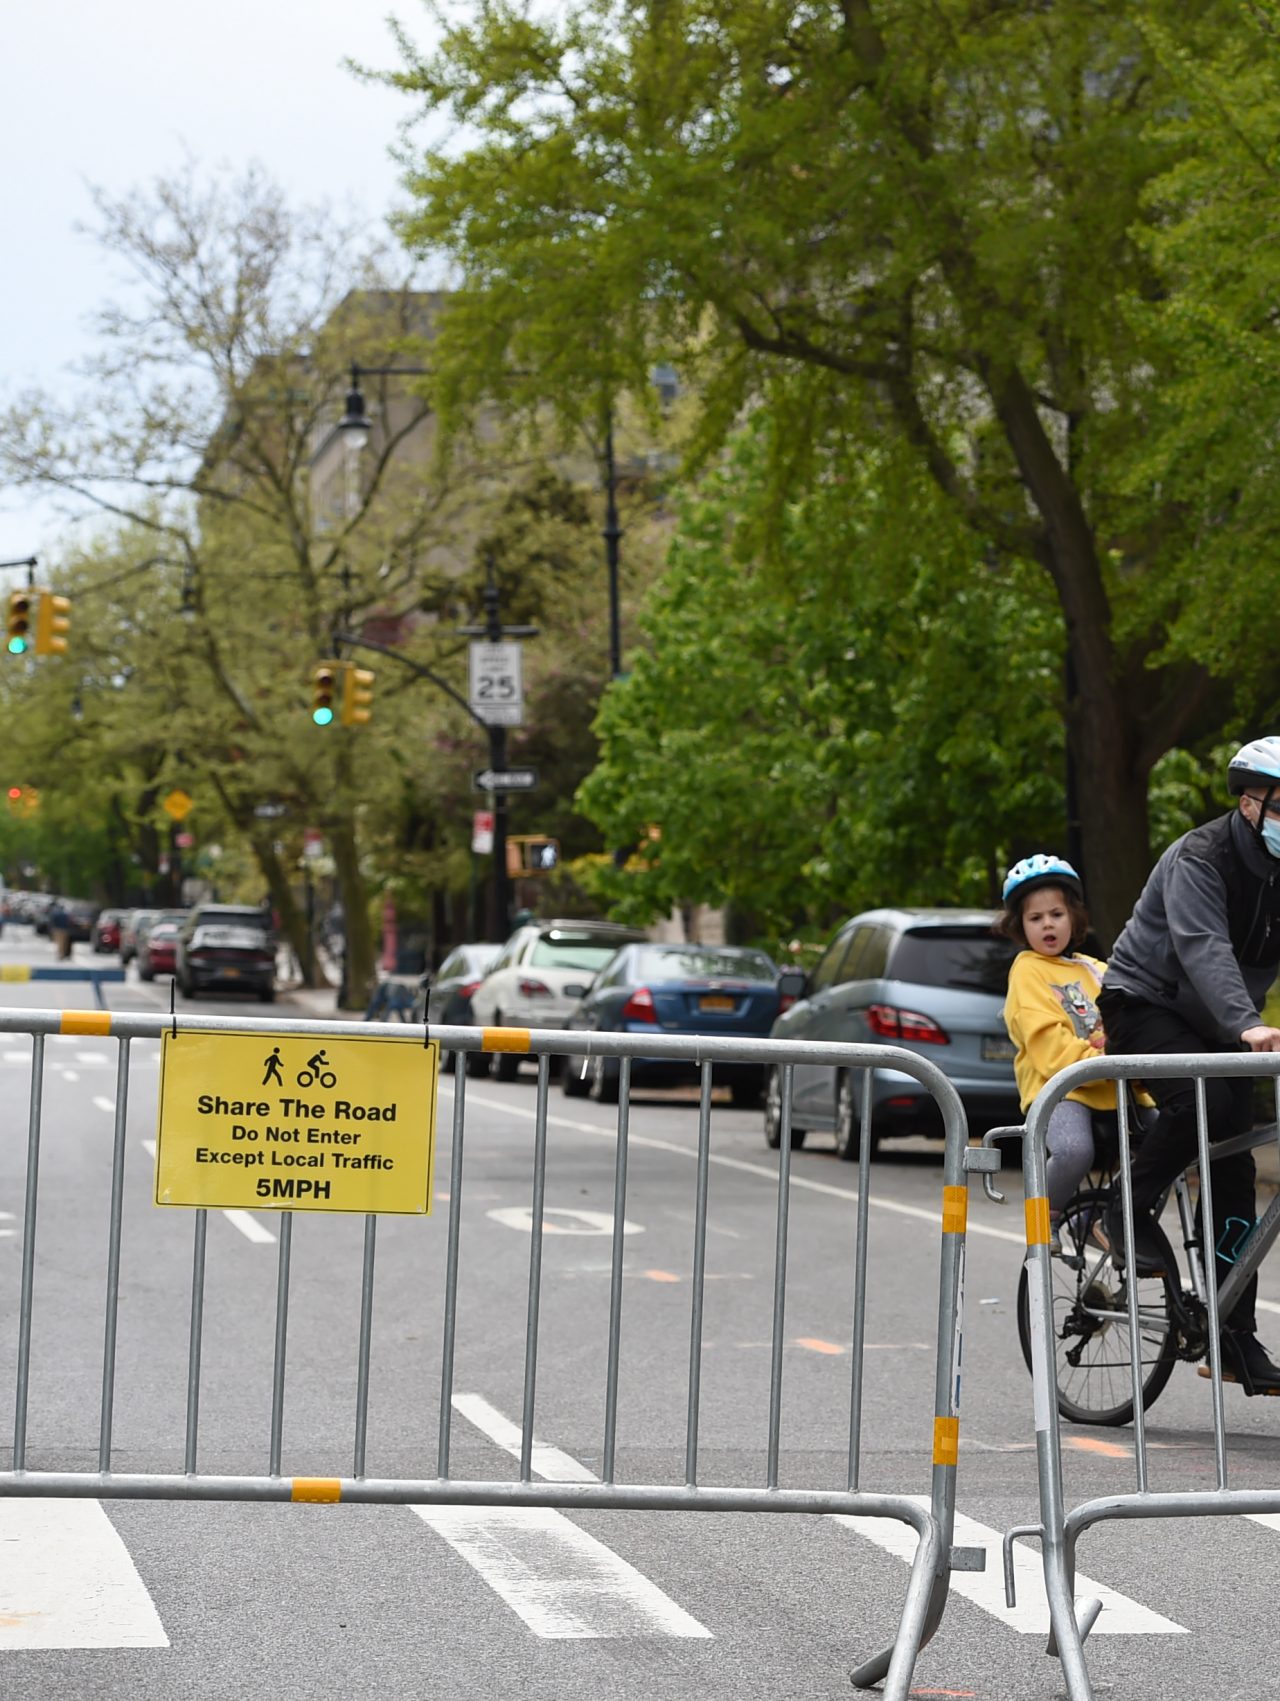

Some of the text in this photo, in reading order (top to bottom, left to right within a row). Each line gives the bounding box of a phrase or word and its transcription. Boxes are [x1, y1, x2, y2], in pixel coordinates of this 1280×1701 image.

[478, 676, 515, 699] 25
[198, 1095, 397, 1122] Share The Road
[232, 1126, 362, 1145] Do Not Enter
[196, 1148, 394, 1170] Except Local Traffic
[256, 1178, 331, 1200] 5MPH
